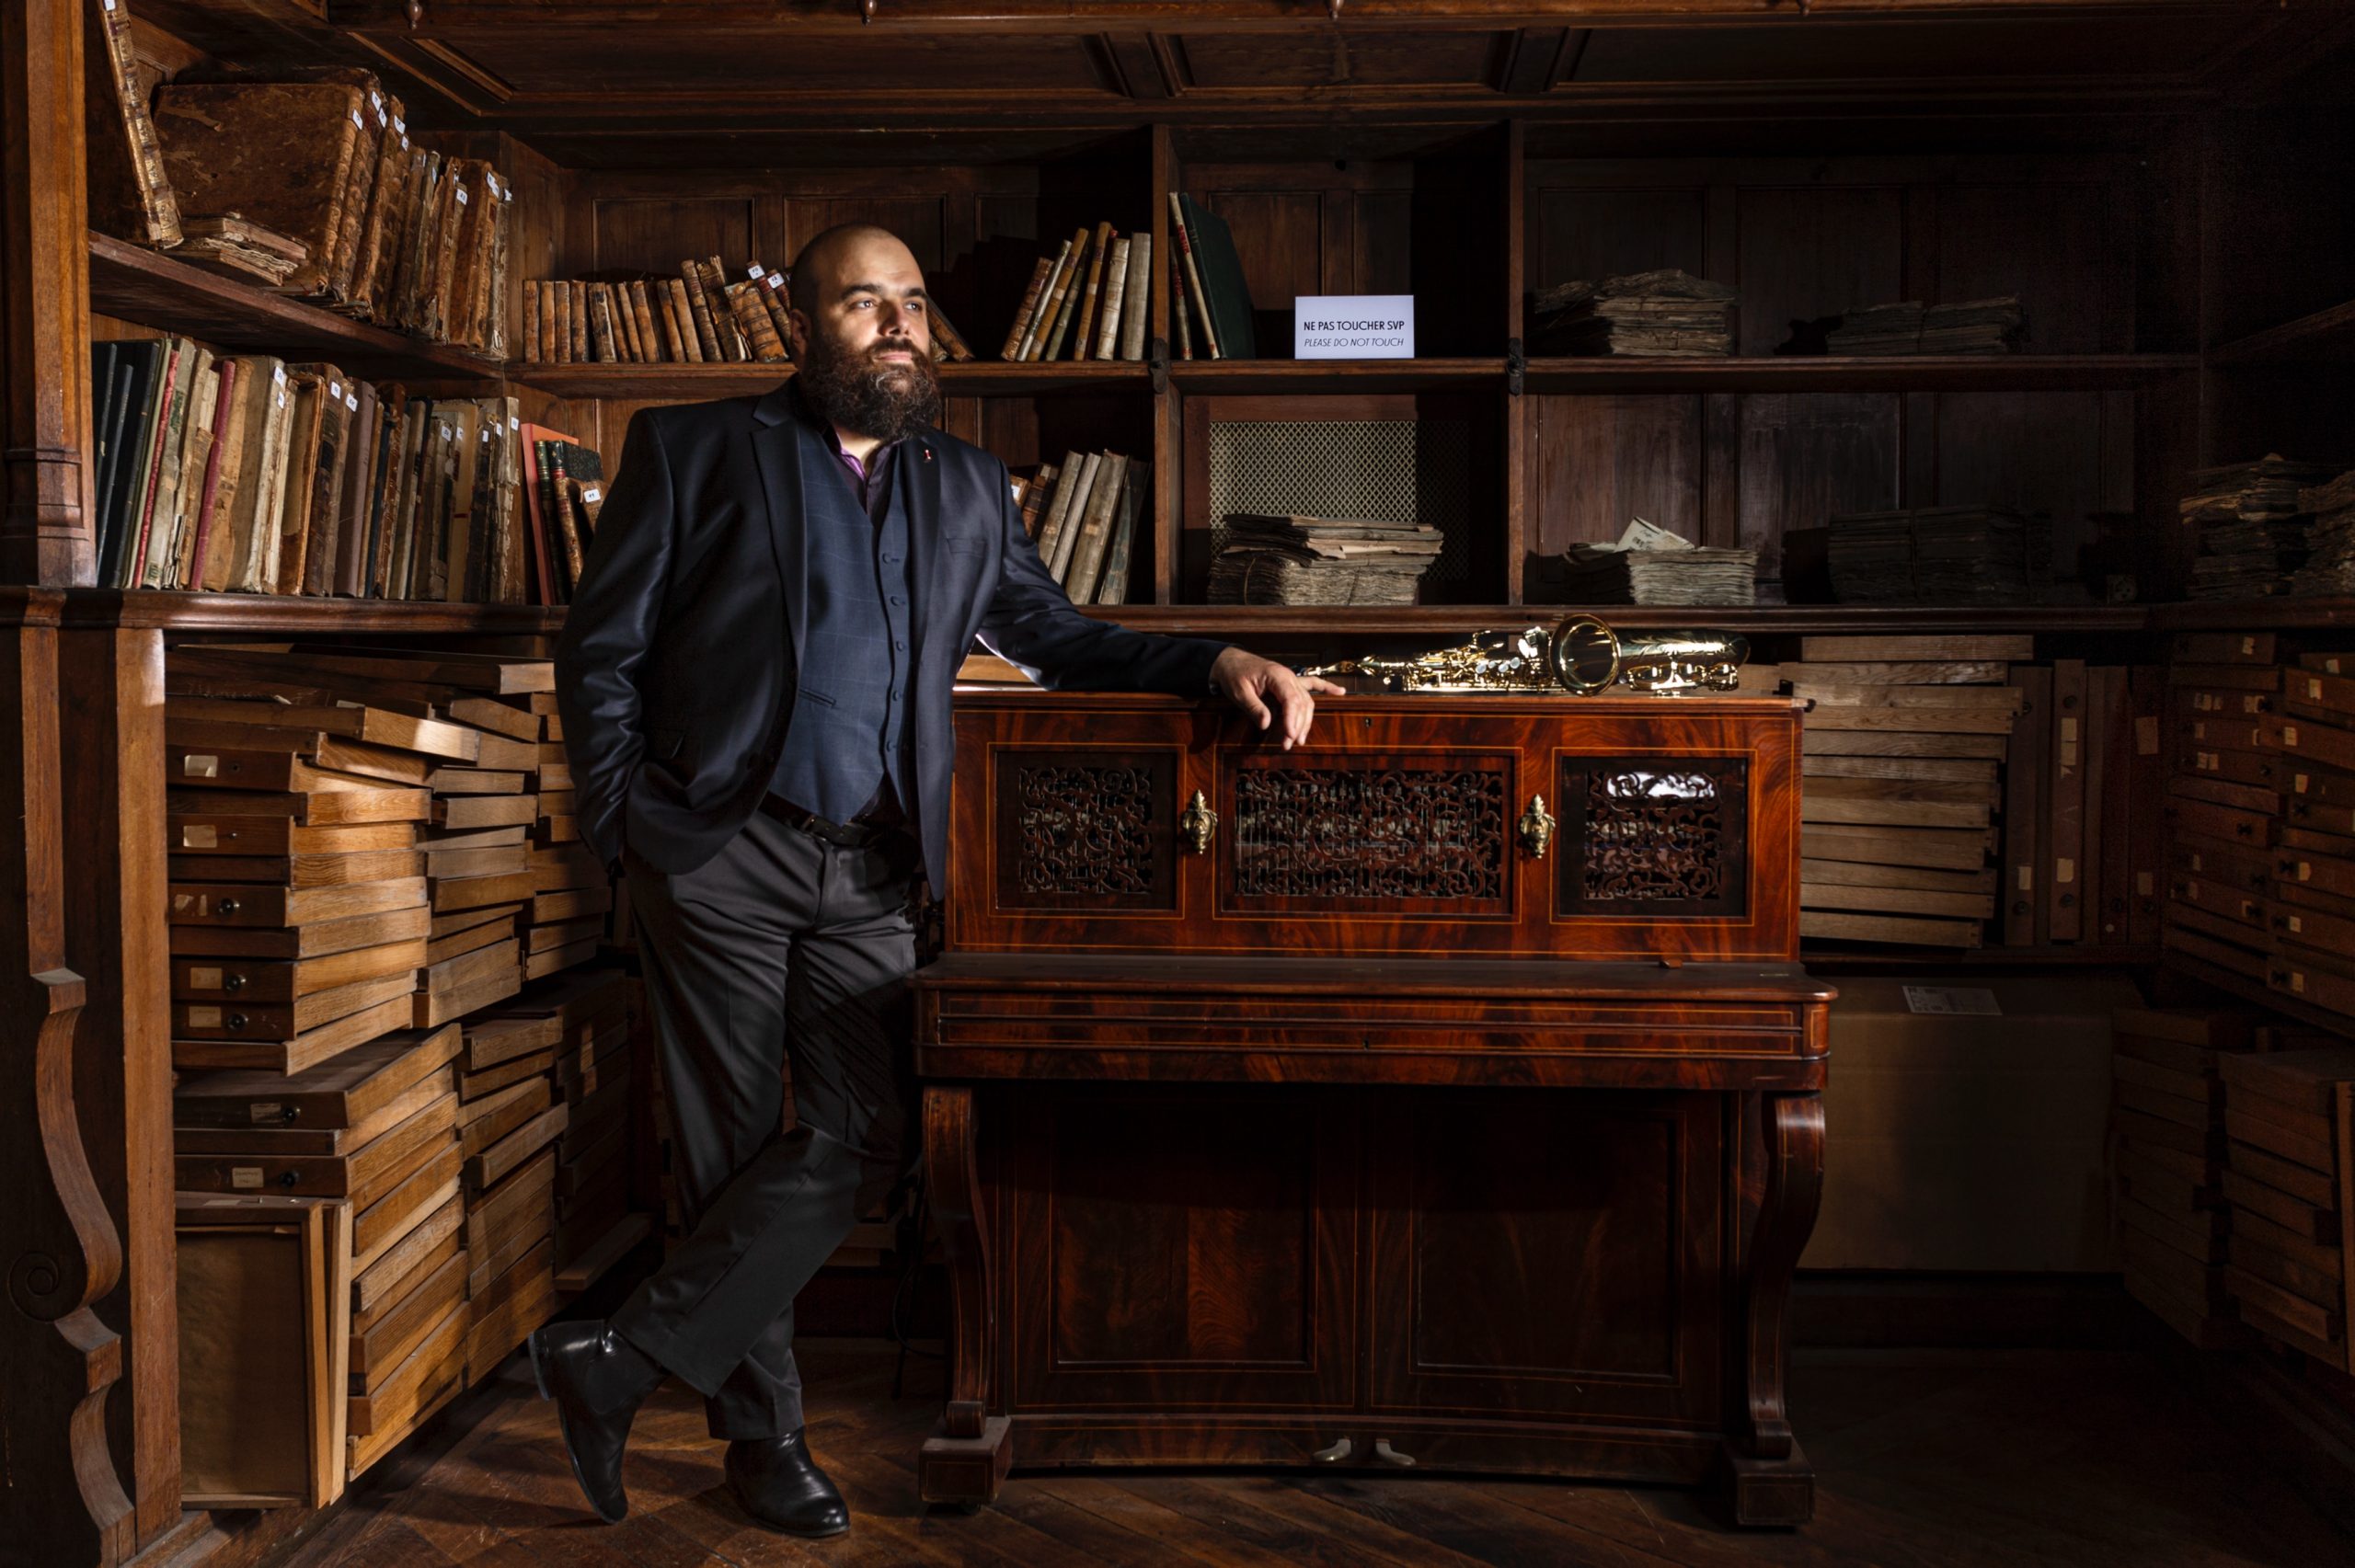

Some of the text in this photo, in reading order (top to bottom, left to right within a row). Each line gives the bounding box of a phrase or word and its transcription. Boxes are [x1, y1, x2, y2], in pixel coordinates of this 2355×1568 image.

[1304, 320, 1405, 330] NE PAS TOUCHER SVP
[1304, 338, 1404, 347] PLEASE DO NOT TOUCH
